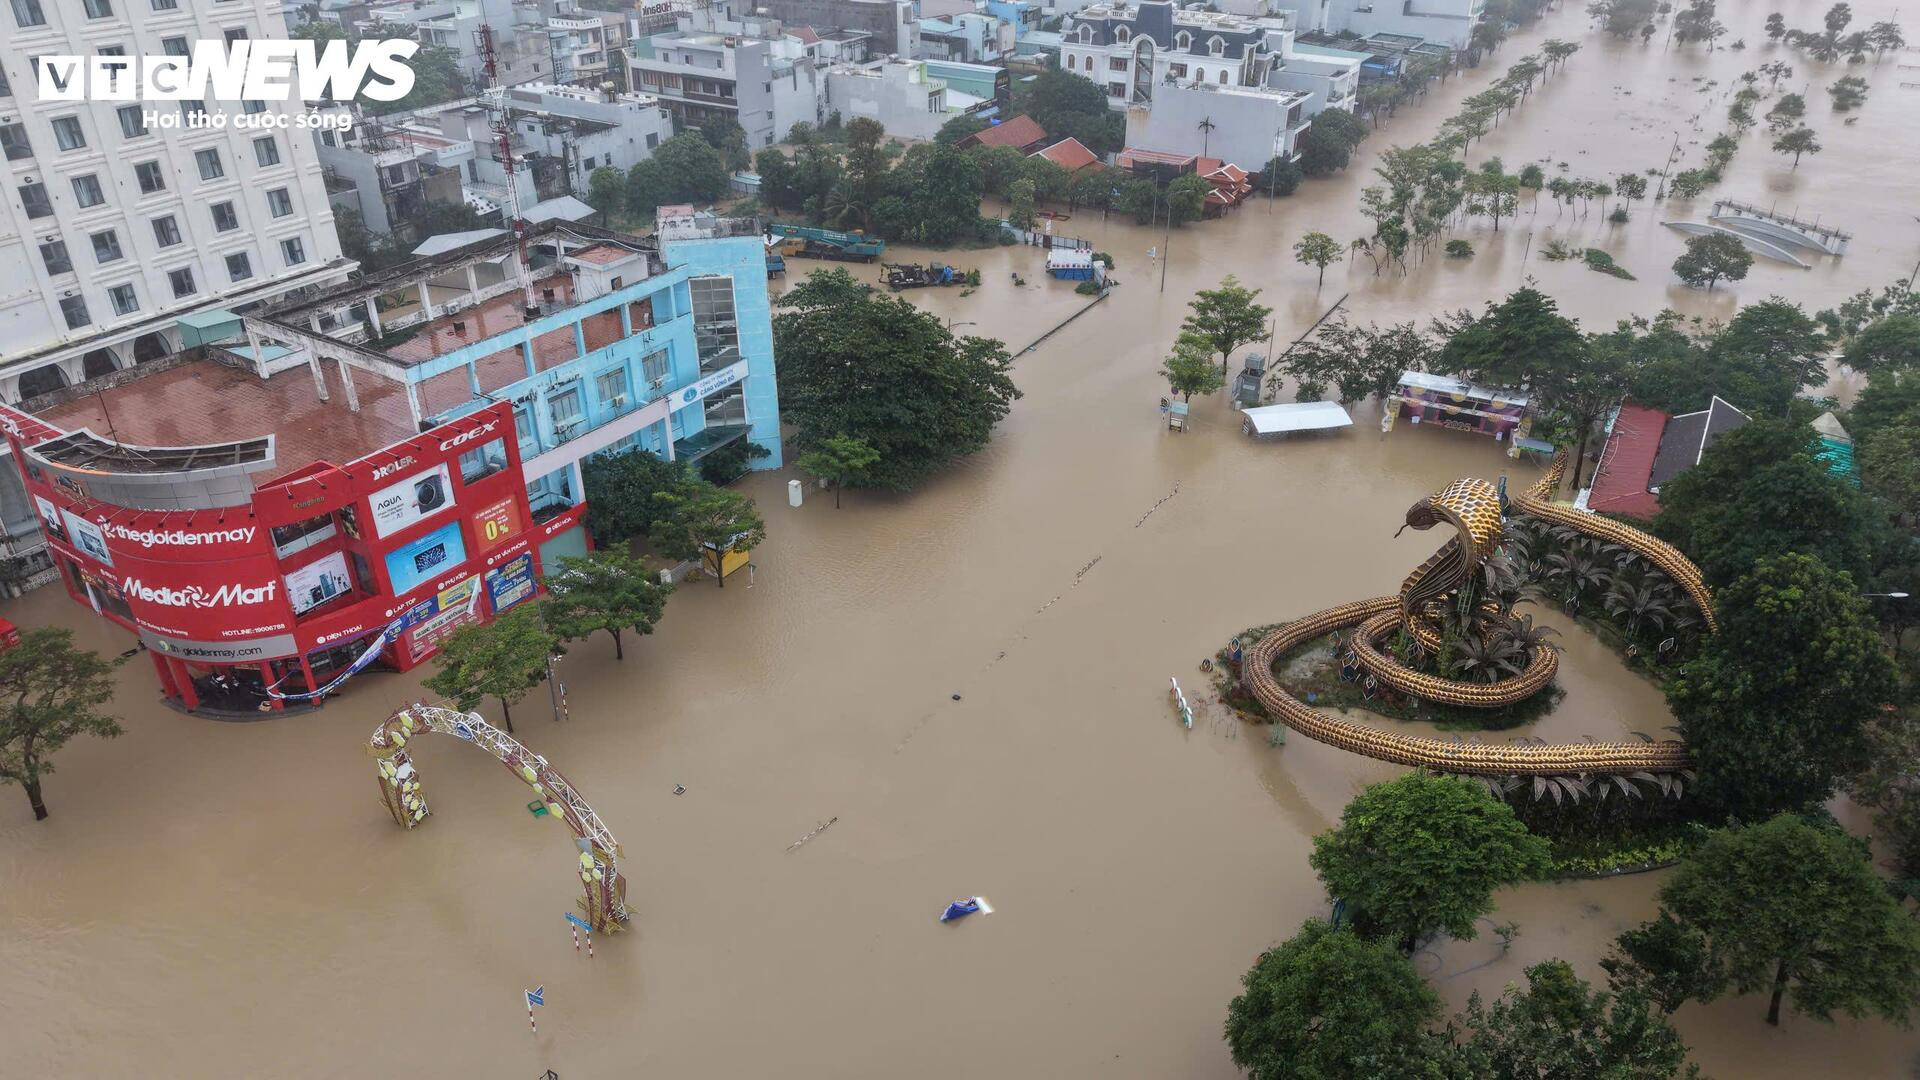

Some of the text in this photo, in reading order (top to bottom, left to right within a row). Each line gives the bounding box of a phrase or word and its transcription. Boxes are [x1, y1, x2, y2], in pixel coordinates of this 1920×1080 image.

[440, 419, 499, 452] COEX
[377, 495, 402, 511] AQUA
[123, 577, 188, 606] Media
[208, 580, 276, 607] Mart
